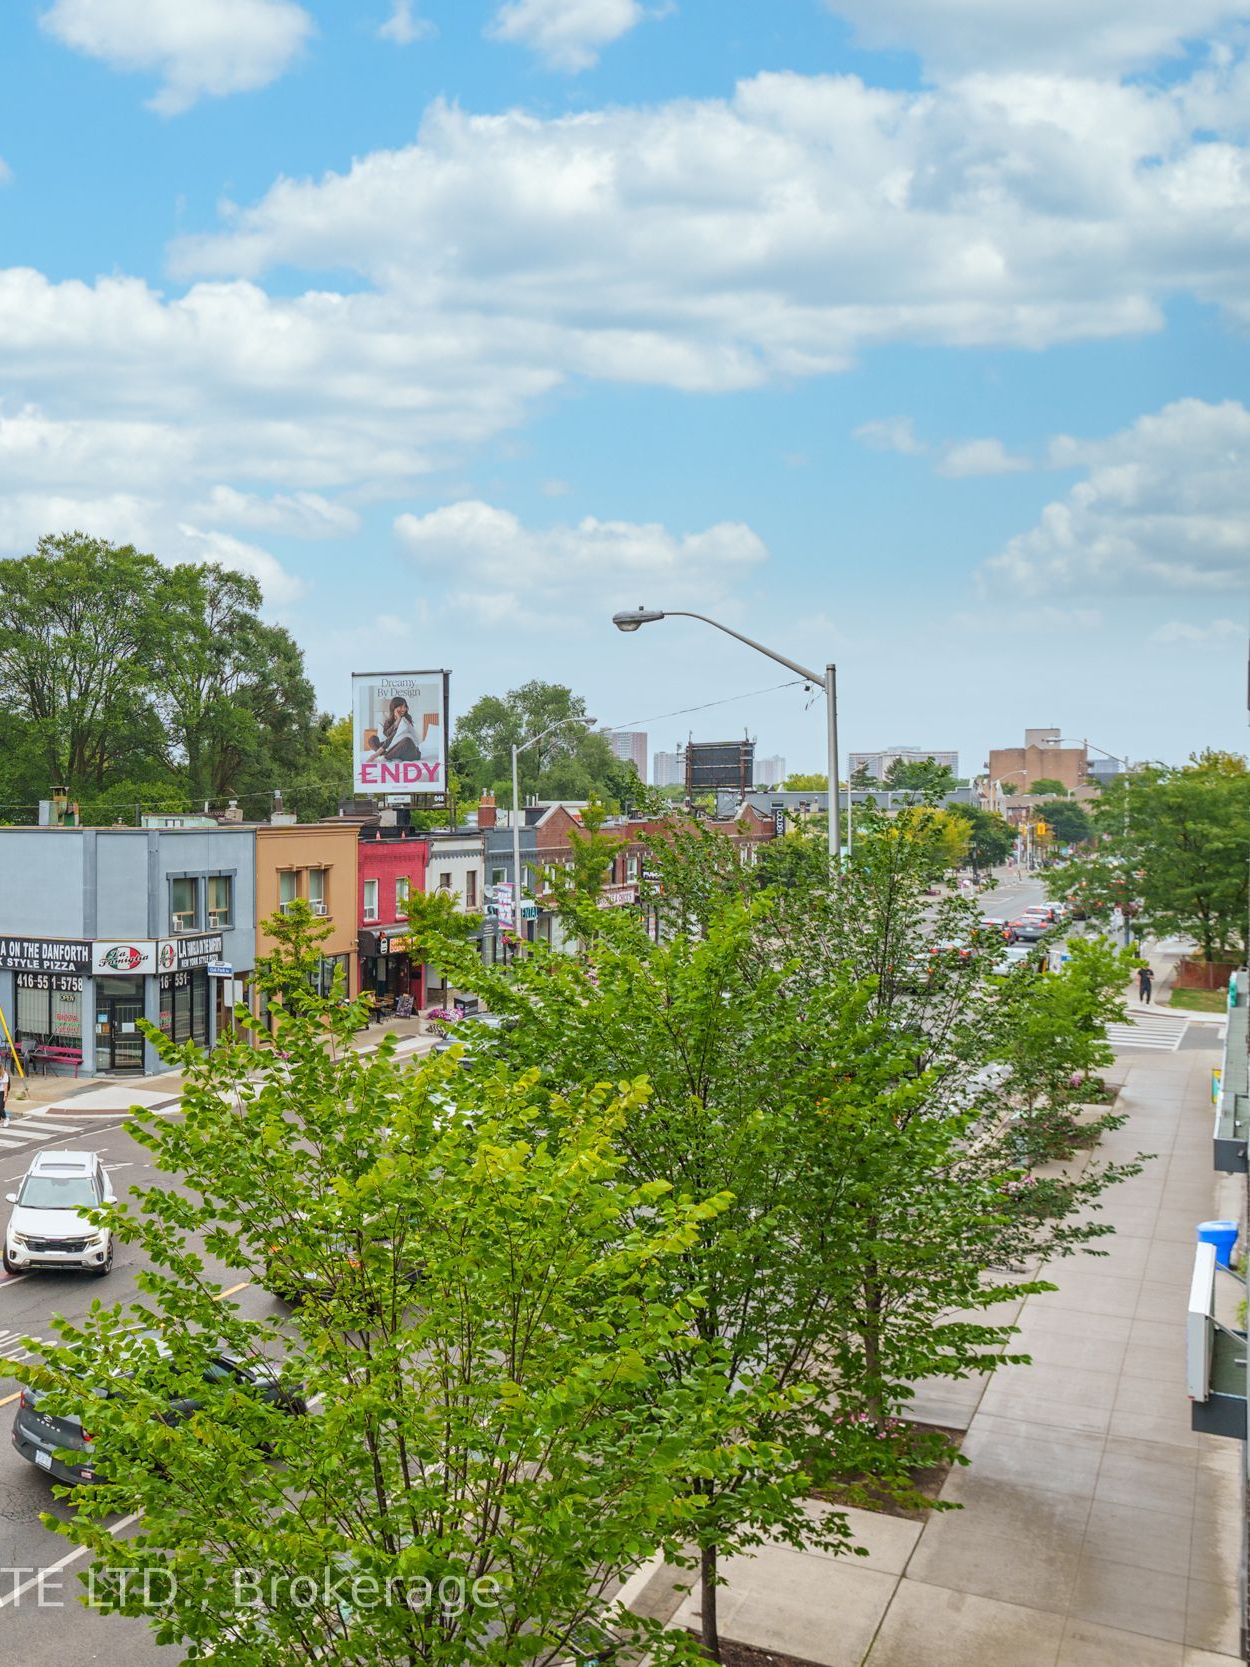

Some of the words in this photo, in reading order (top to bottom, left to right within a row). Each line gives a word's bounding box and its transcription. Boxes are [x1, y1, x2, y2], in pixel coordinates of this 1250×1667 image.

[381, 678, 416, 689] Dreamy
[377, 688, 389, 698] By
[390, 688, 421, 698] Design
[361, 762, 441, 784] ENDY
[9, 941, 21, 957] ON
[23, 942, 39, 959] THE
[110, 950, 126, 959] La
[178, 939, 187, 959] LA
[7, 958, 40, 969] STYLE
[43, 960, 76, 971] PIZZA
[98, 954, 149, 967] Famiglia
[181, 959, 189, 968] NEW
[190, 957, 199, 967] YORK
